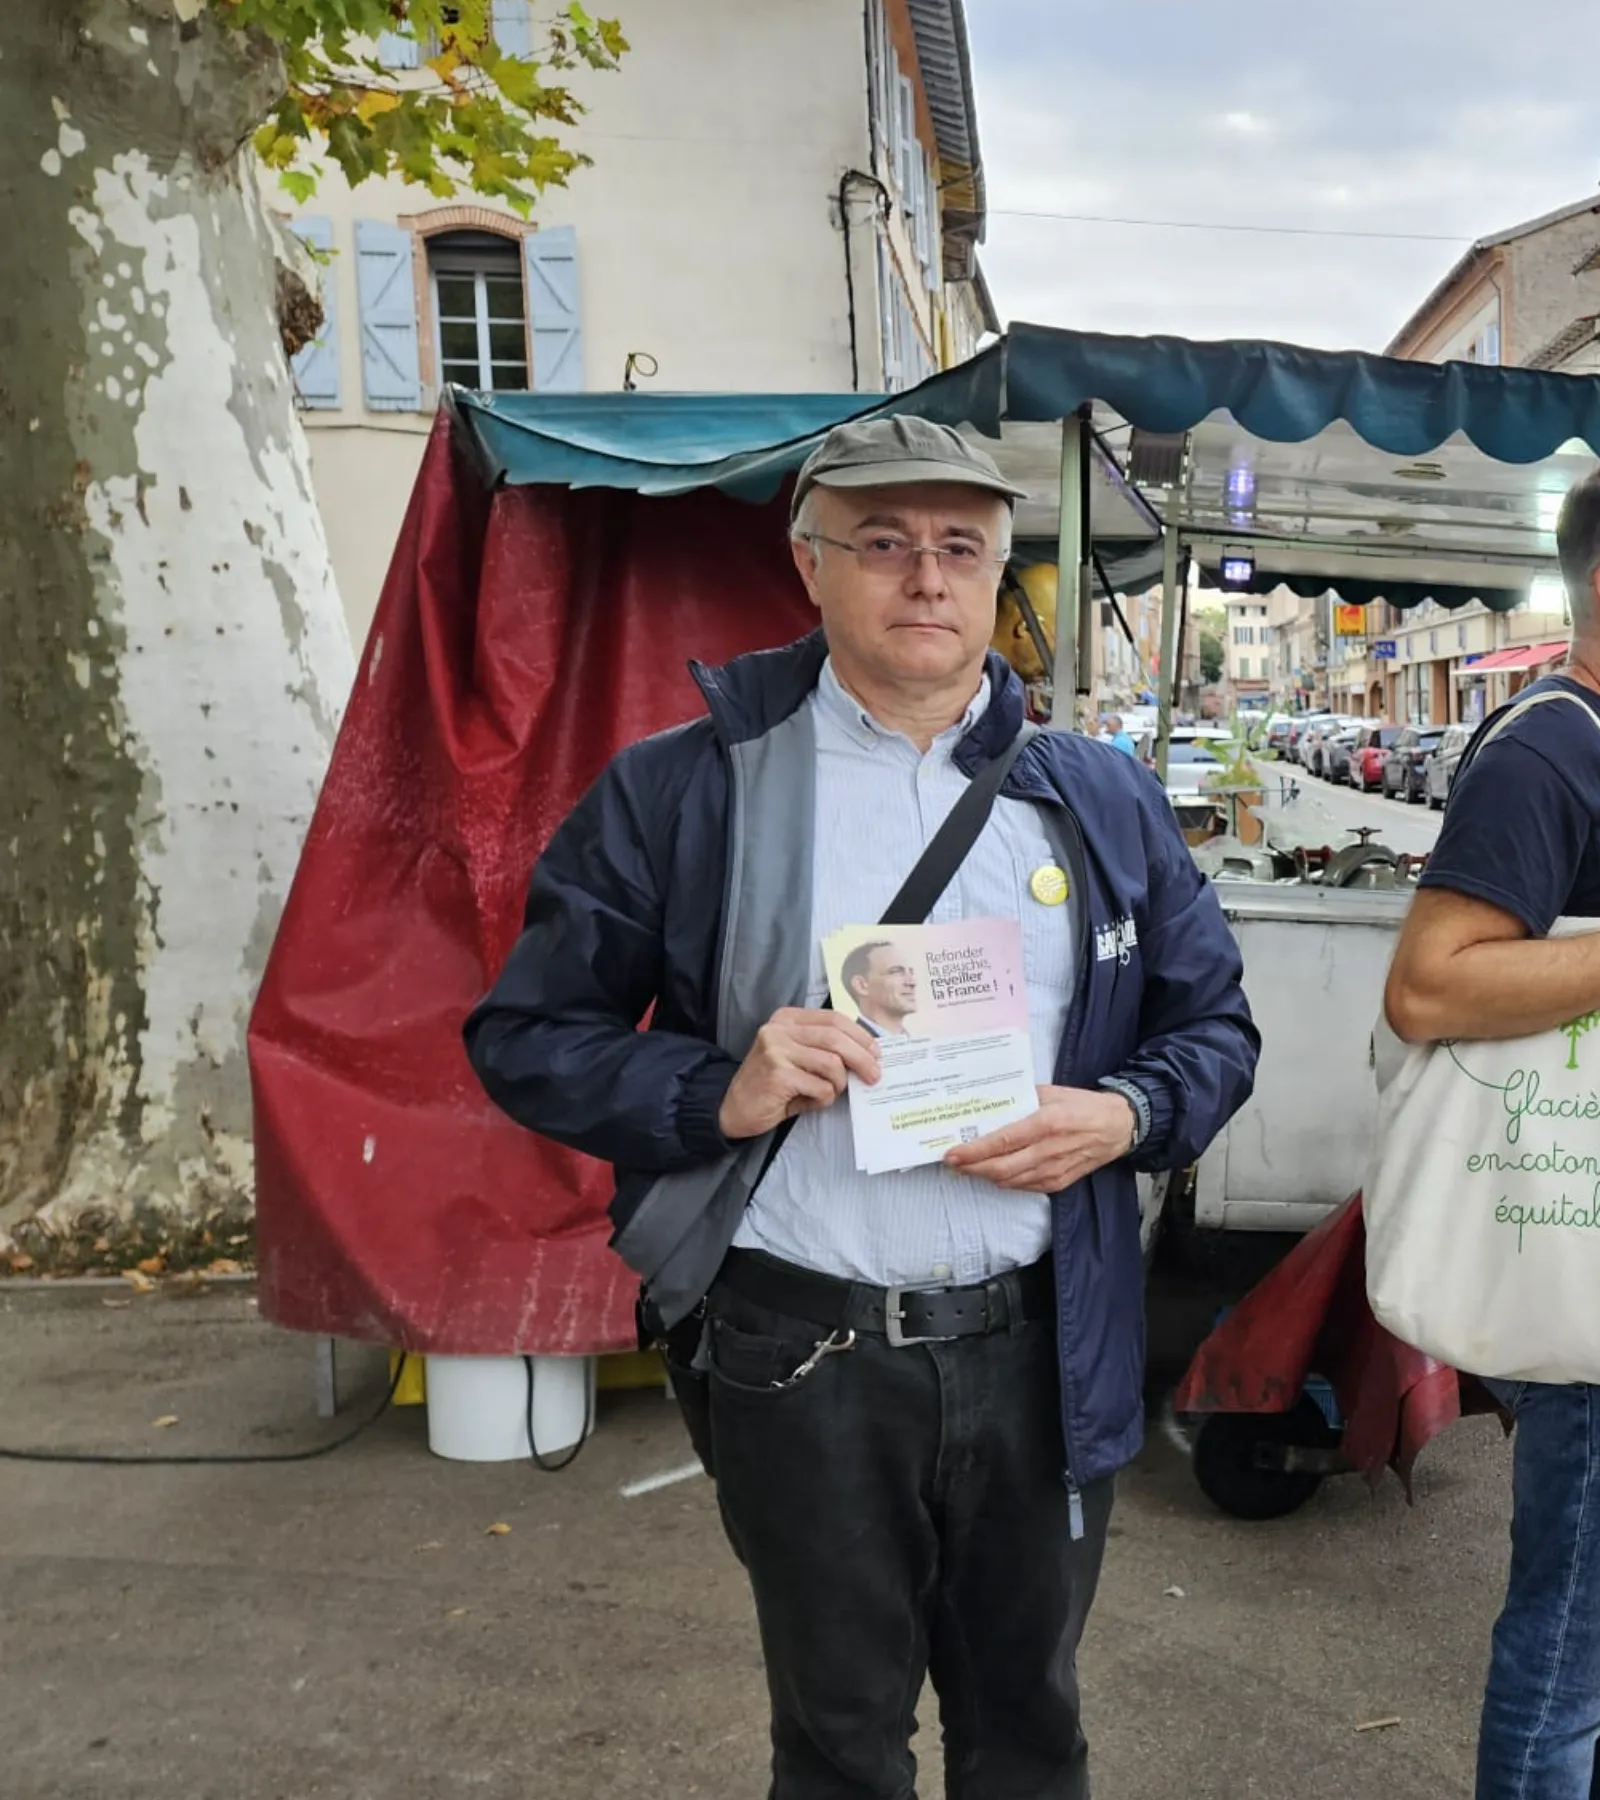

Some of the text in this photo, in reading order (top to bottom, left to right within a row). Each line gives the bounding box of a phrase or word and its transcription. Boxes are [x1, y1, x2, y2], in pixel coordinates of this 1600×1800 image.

[925, 945, 984, 963] Refonder
[927, 960, 940, 976] la
[932, 986, 945, 1000] la
[947, 983, 991, 998] France
[1466, 1152, 1503, 1173] en
